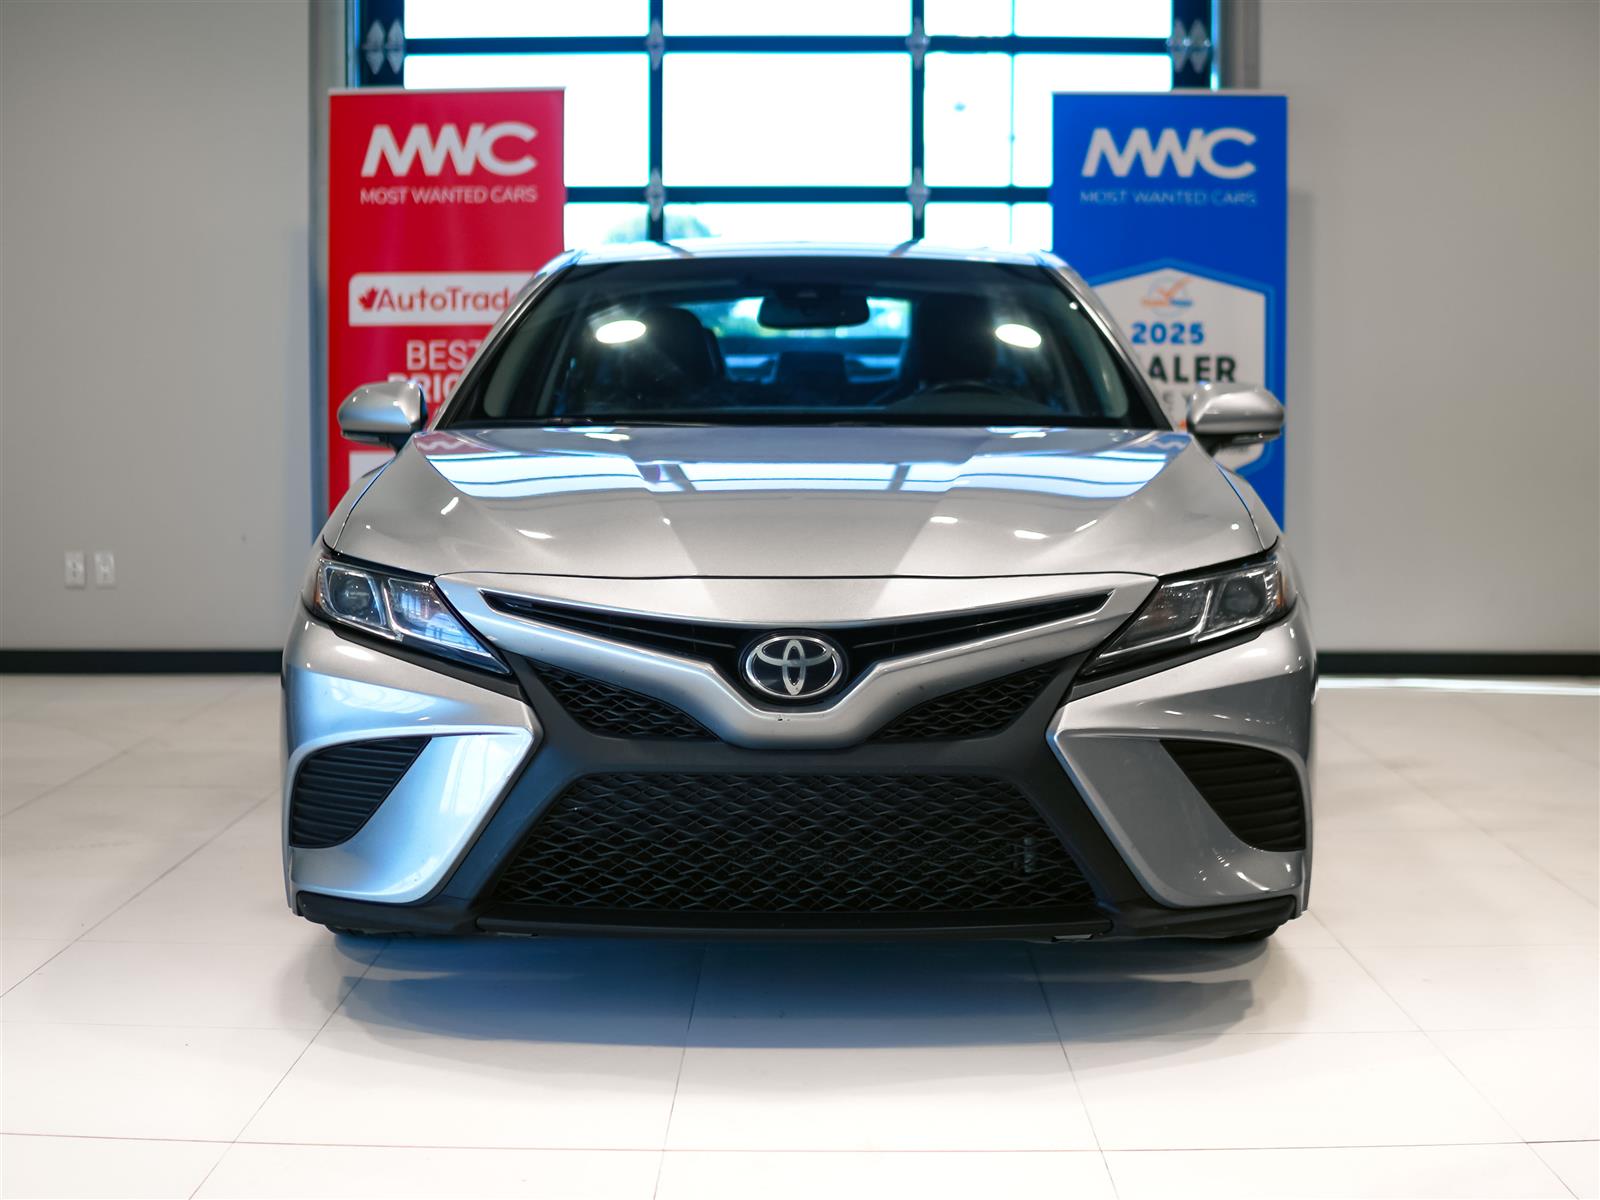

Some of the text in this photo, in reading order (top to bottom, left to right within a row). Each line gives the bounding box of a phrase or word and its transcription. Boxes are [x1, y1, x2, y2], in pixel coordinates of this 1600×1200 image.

[361, 121, 538, 178] MWC
[1081, 127, 1257, 180] MWC
[360, 184, 538, 205] MOST WANTED CARS
[1080, 190, 1127, 205] MOST
[1133, 190, 1206, 205] WANTED
[1131, 321, 1205, 345] 2025
[1148, 353, 1236, 384] ALER
